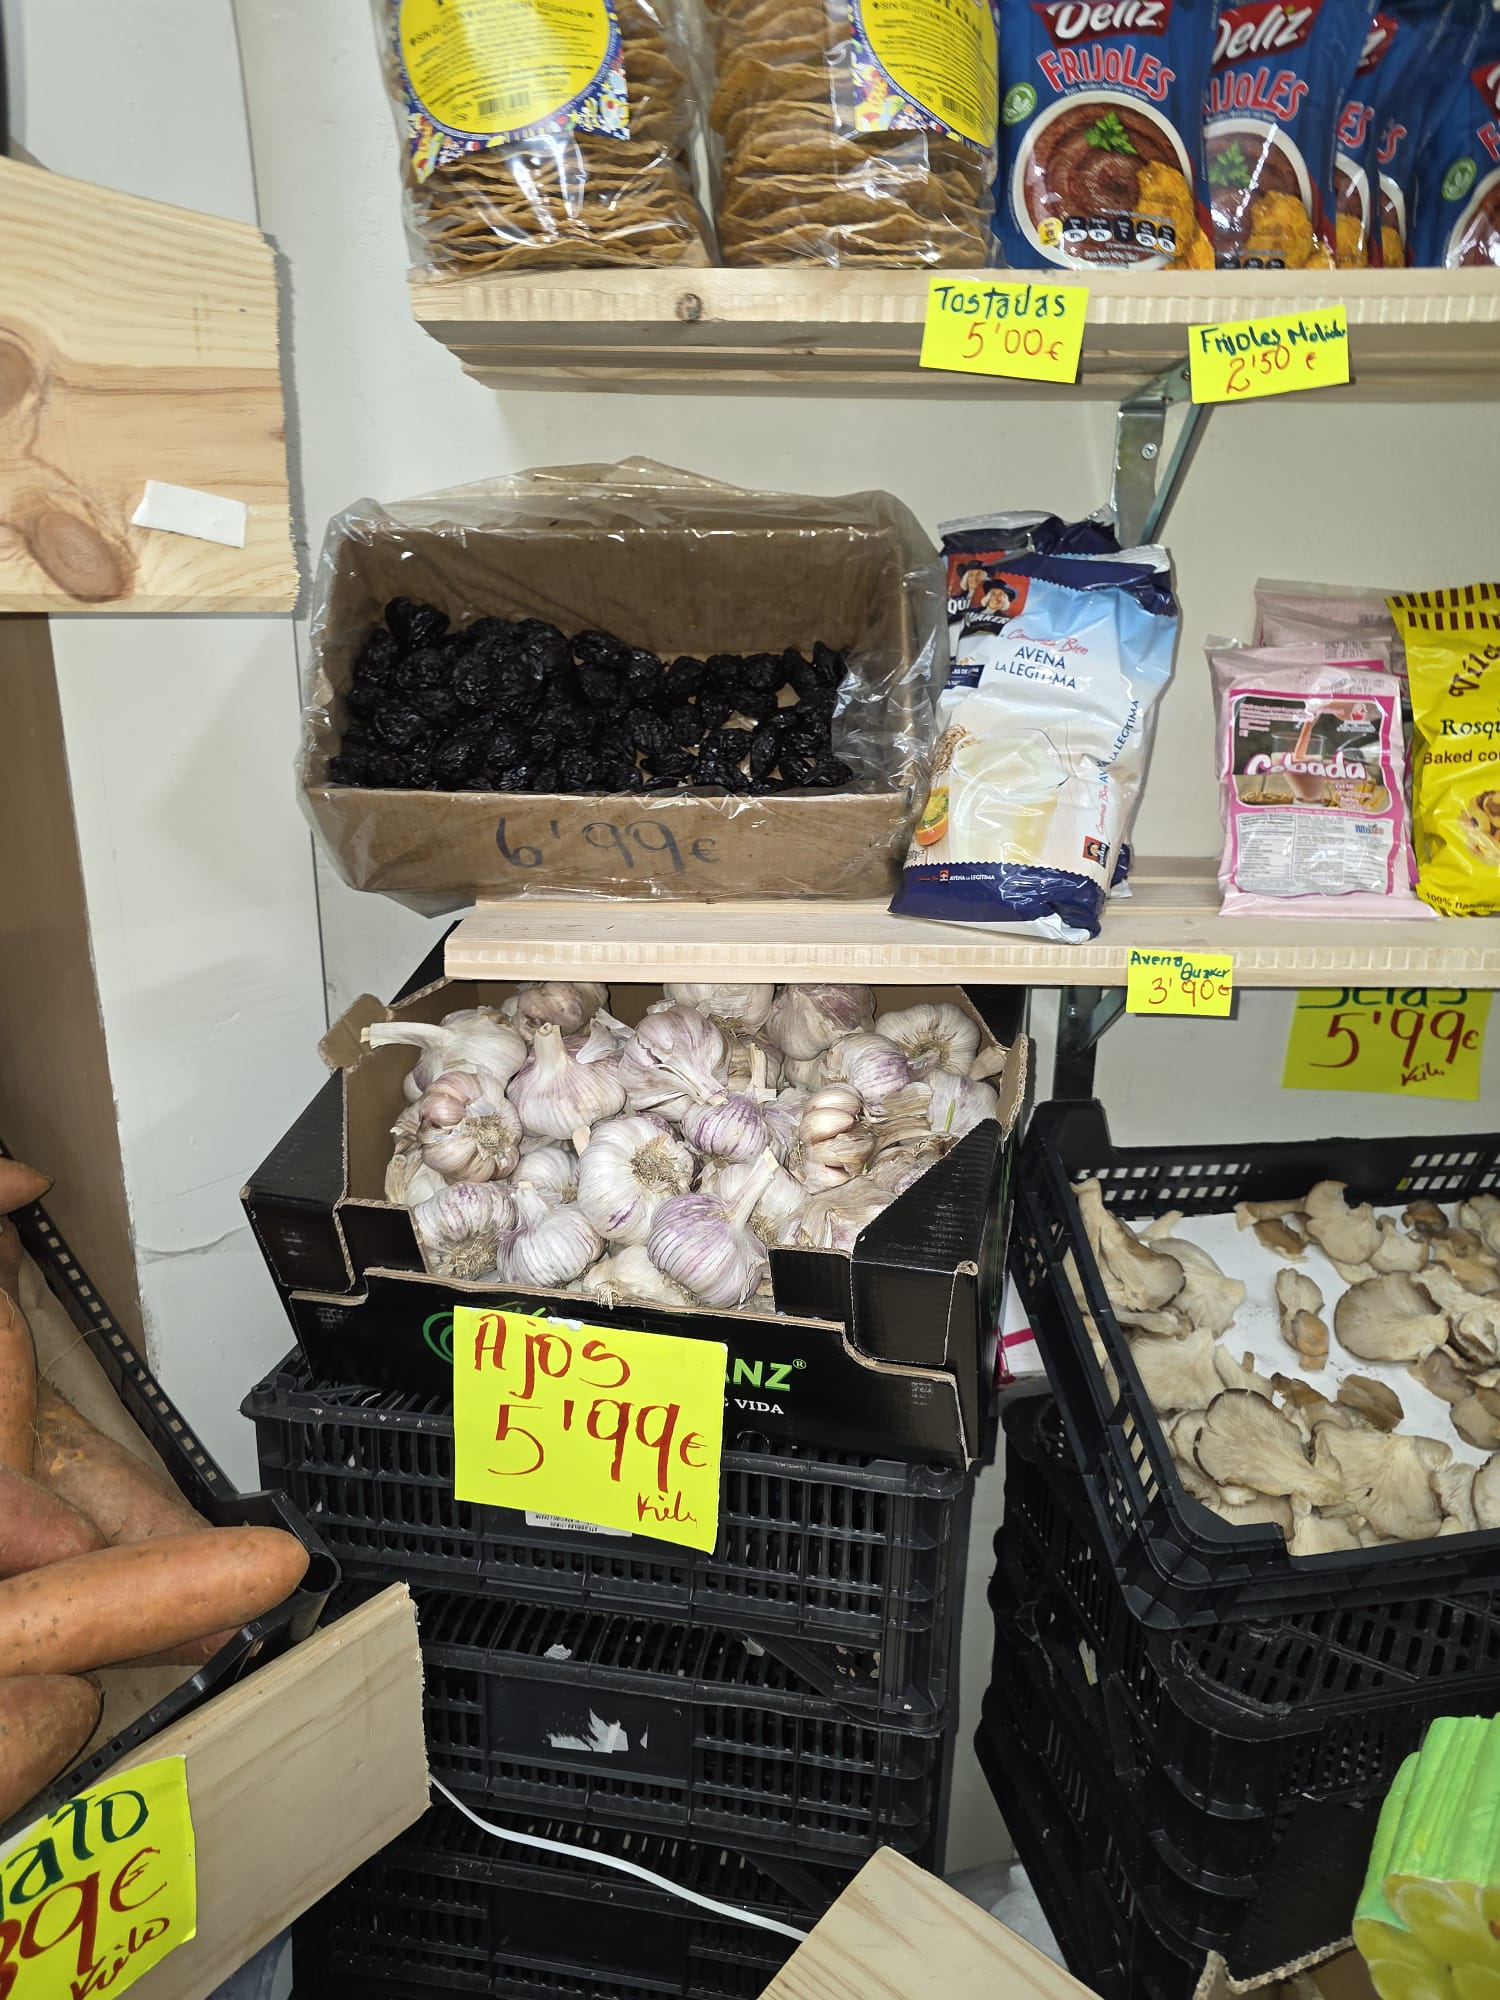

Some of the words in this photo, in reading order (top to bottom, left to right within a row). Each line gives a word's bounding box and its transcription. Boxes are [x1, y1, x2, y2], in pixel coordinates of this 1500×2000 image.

[1046, 0, 1165, 39] Deliz
[1036, 43, 1176, 102] FRIJOLES
[1203, 66, 1309, 121] IJOLES
[934, 284, 1066, 320] Tostadas
[1200, 326, 1281, 356] Frijoles
[995, 661, 1006, 672] LA
[1015, 646, 1066, 669] AVENA
[1424, 749, 1473, 765] Baked
[1478, 751, 1500, 763] co
[474, 1313, 631, 1400] Ajos
[733, 1398, 785, 1415] VIDA
